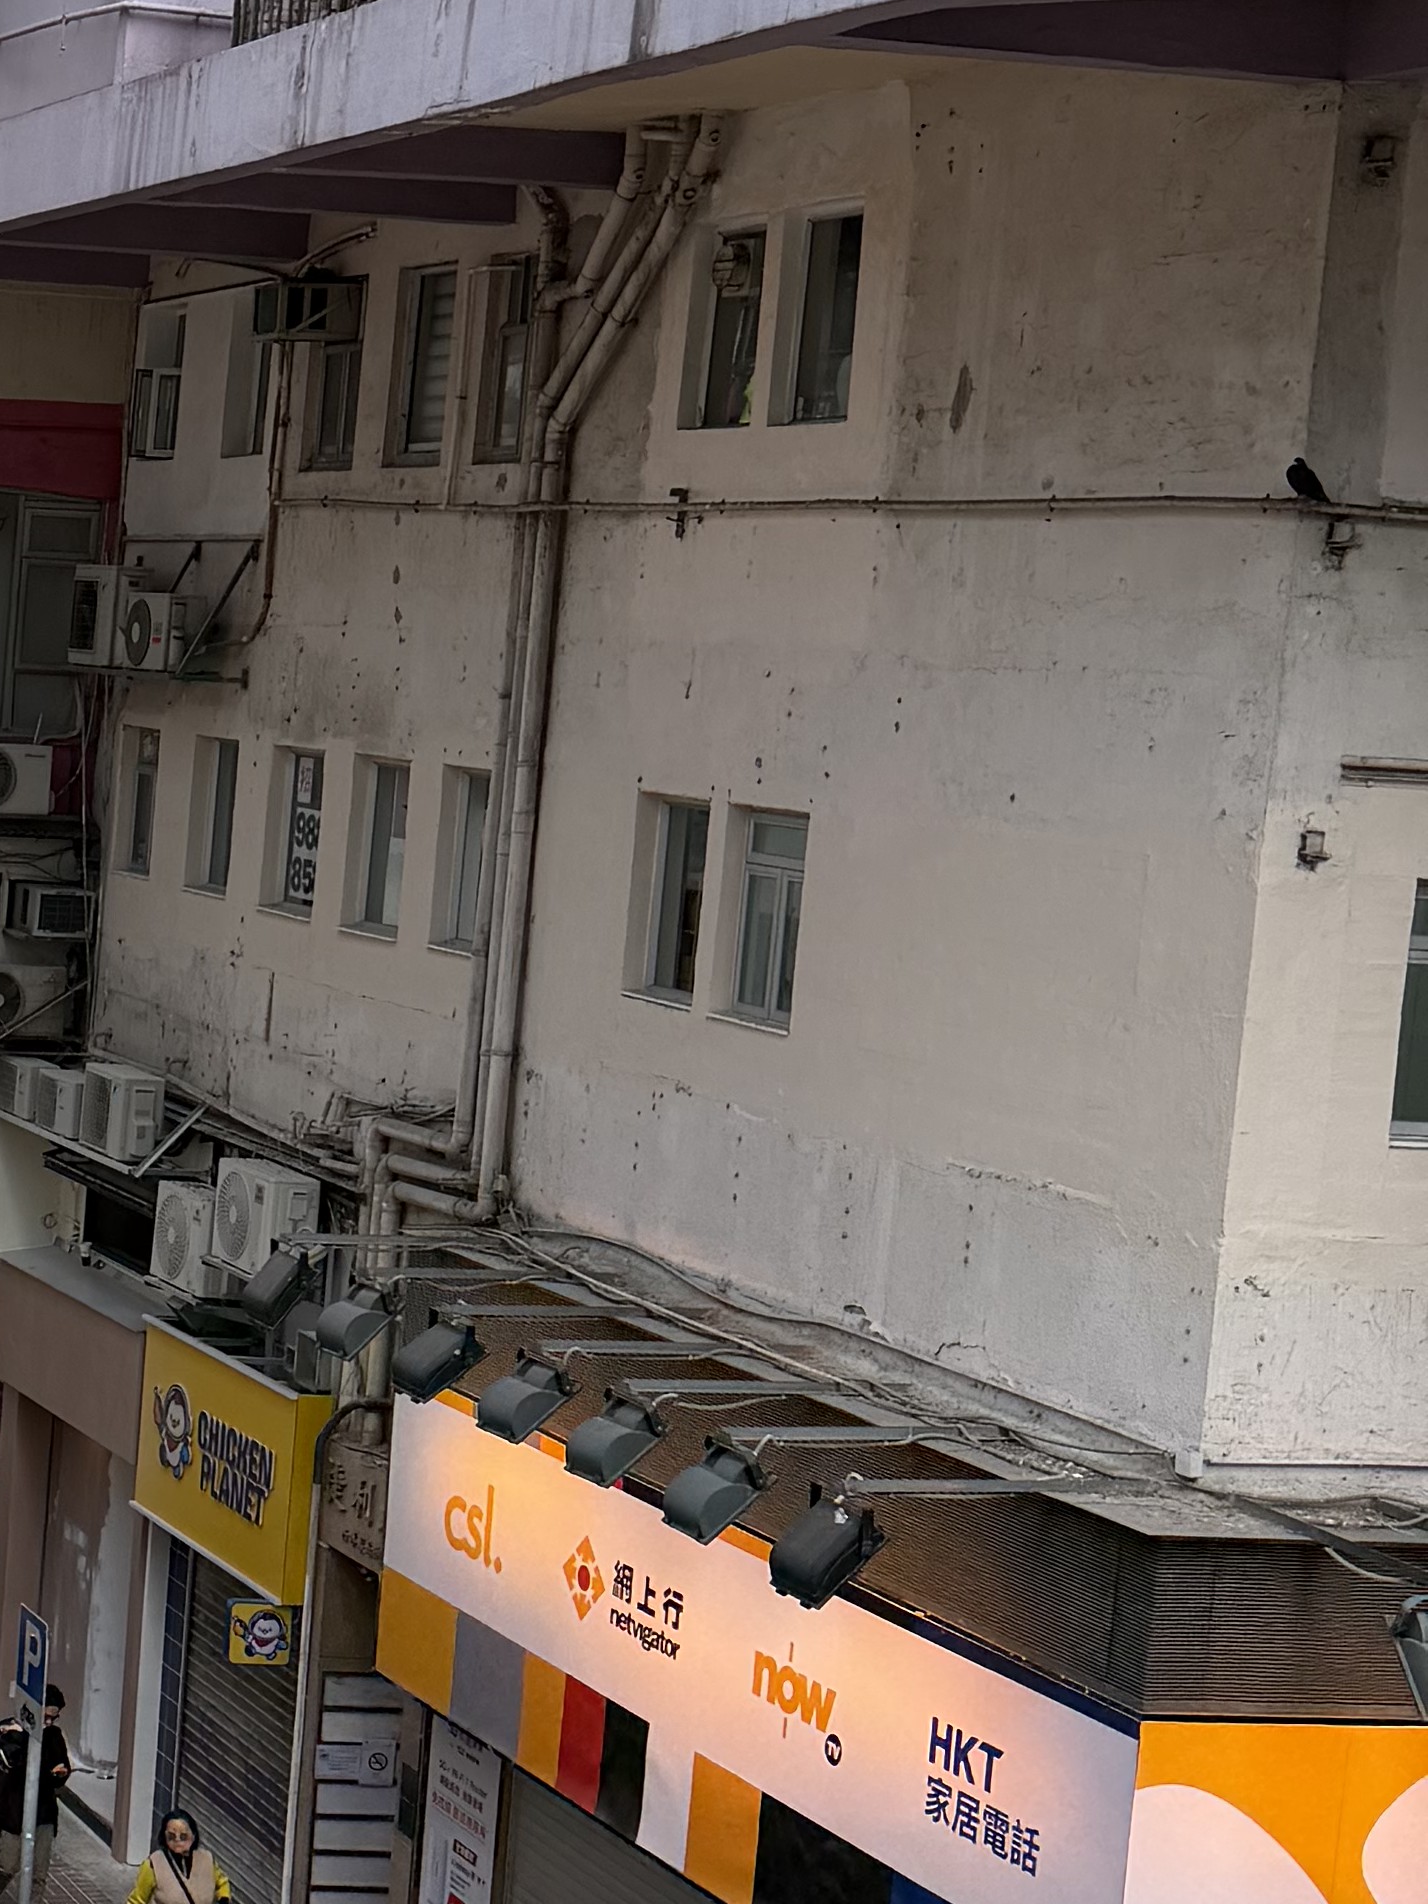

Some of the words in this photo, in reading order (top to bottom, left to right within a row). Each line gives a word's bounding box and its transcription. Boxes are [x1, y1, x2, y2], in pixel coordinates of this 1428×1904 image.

[198, 1410, 275, 1491] CHICKEN
[200, 1453, 268, 1527] PLANET
[444, 1484, 502, 1574] csl.
[611, 1559, 684, 1631] 網上行
[22, 1619, 42, 1686] P
[610, 1606, 681, 1661] netvigator
[751, 1643, 837, 1737] now
[827, 1741, 842, 1761] TV
[928, 1716, 1005, 1794] HKT
[924, 1774, 1041, 1877] 家居電話
